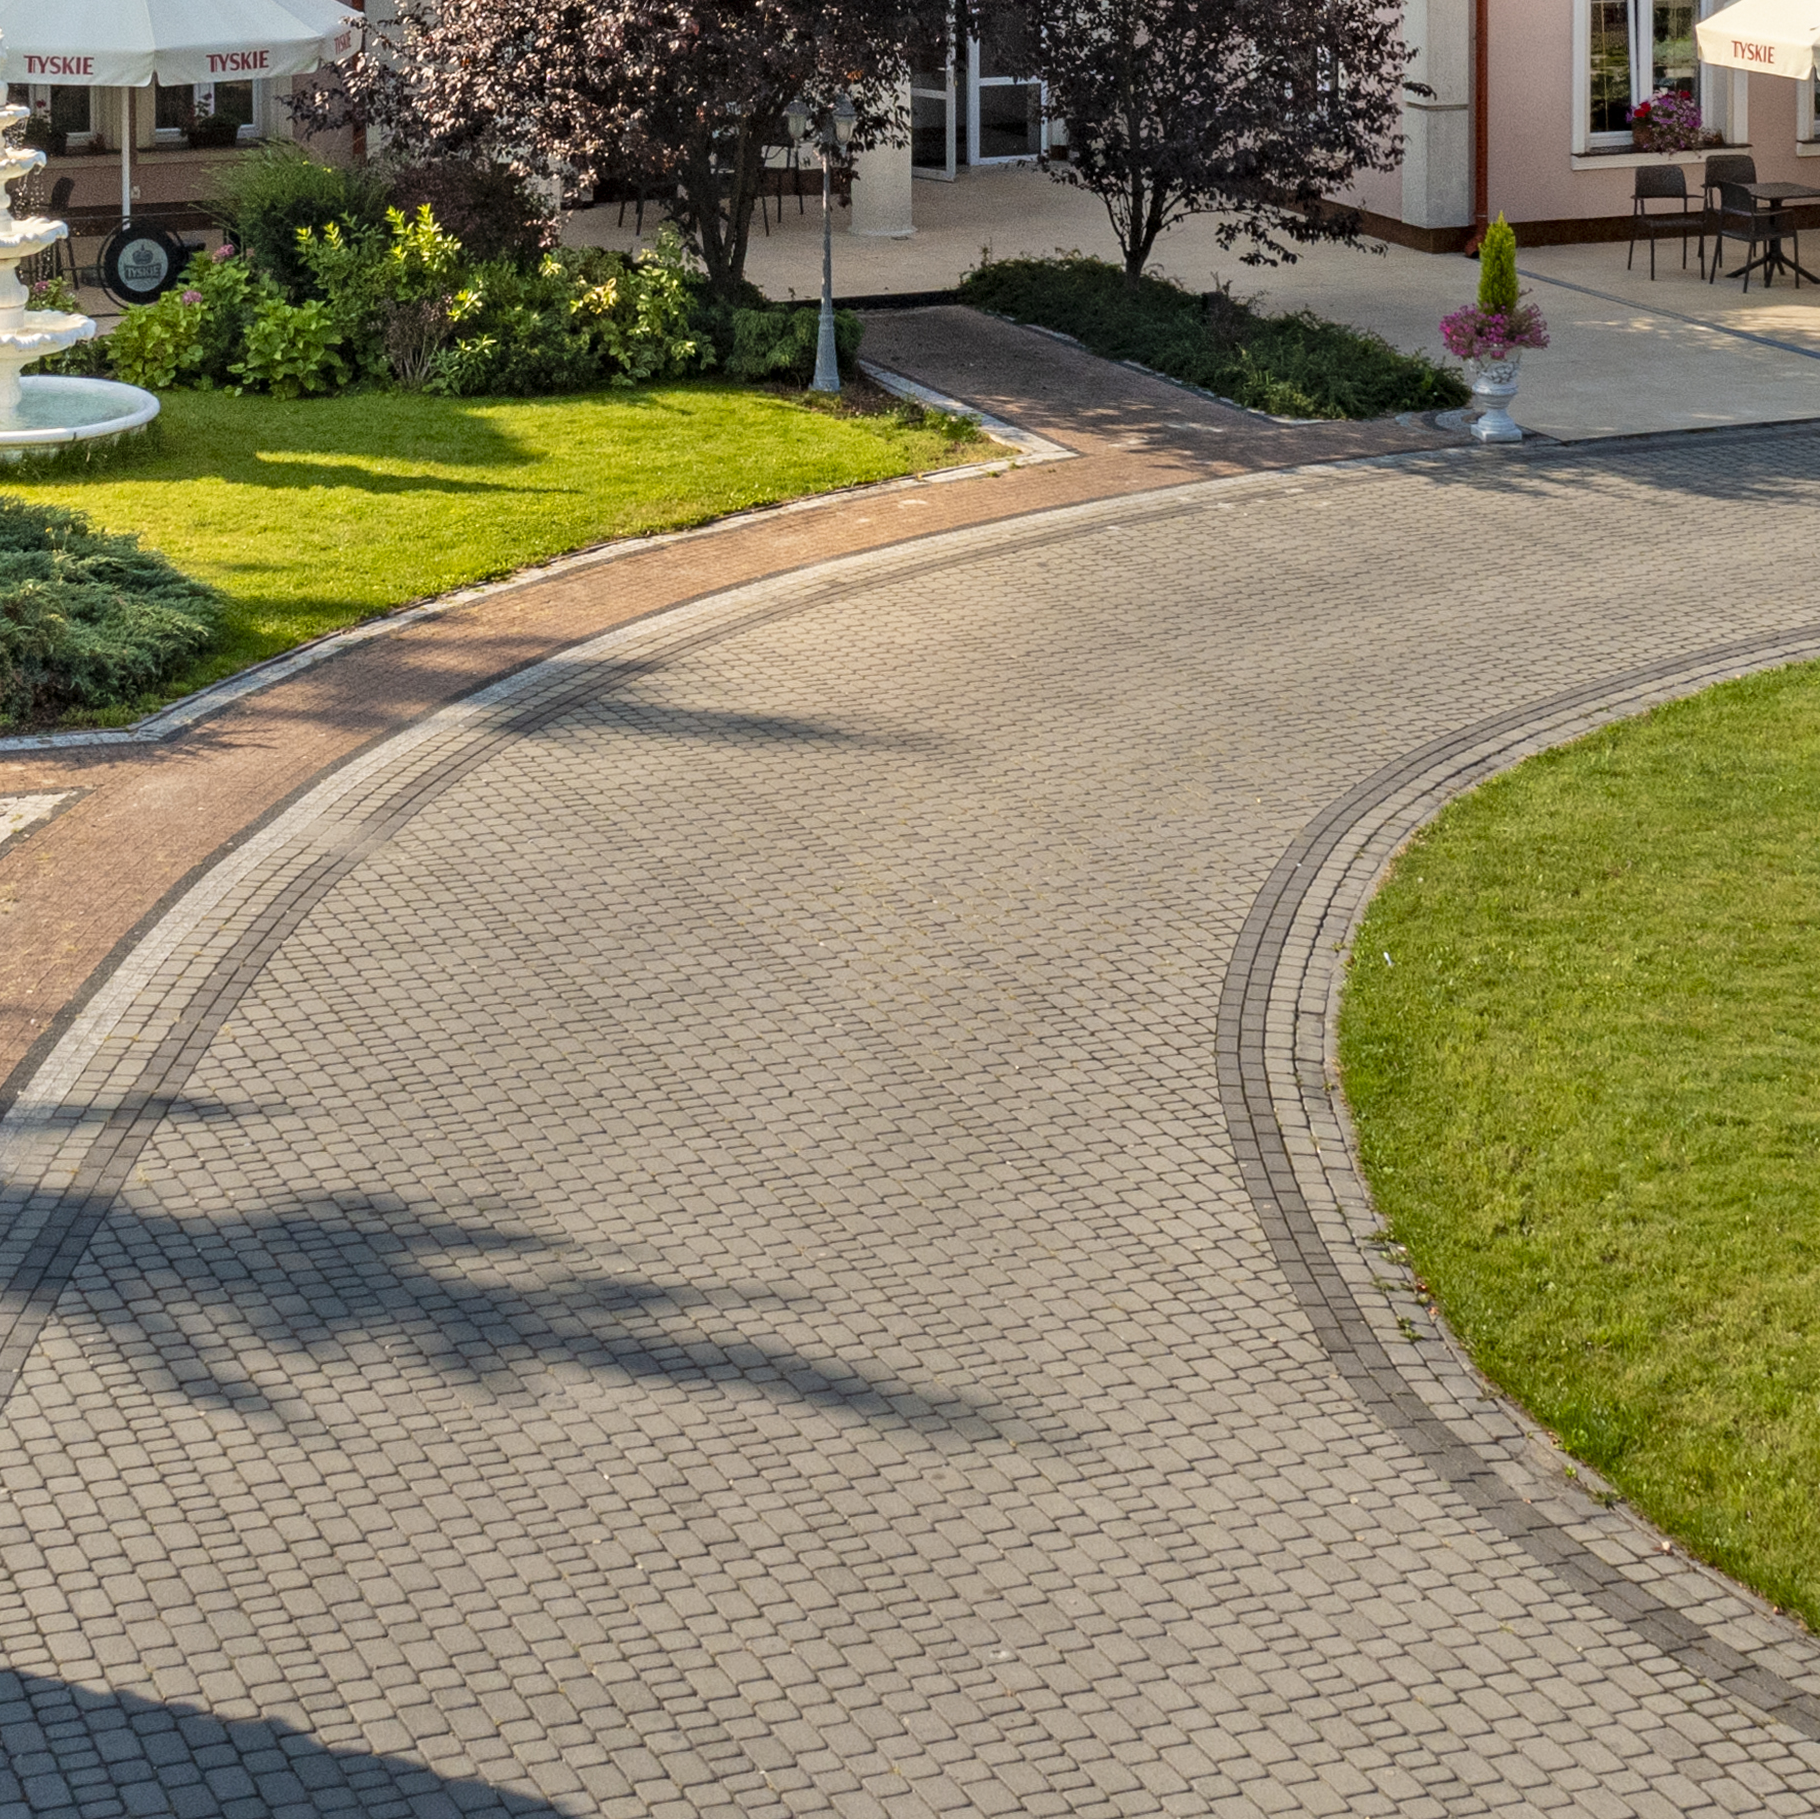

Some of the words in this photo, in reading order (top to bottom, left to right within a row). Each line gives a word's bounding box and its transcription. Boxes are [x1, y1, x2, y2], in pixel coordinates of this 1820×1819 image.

[206, 50, 269, 72] TYSKIE
[1732, 40, 1775, 64] TYSKIE
[24, 55, 94, 75] TYSKIE
